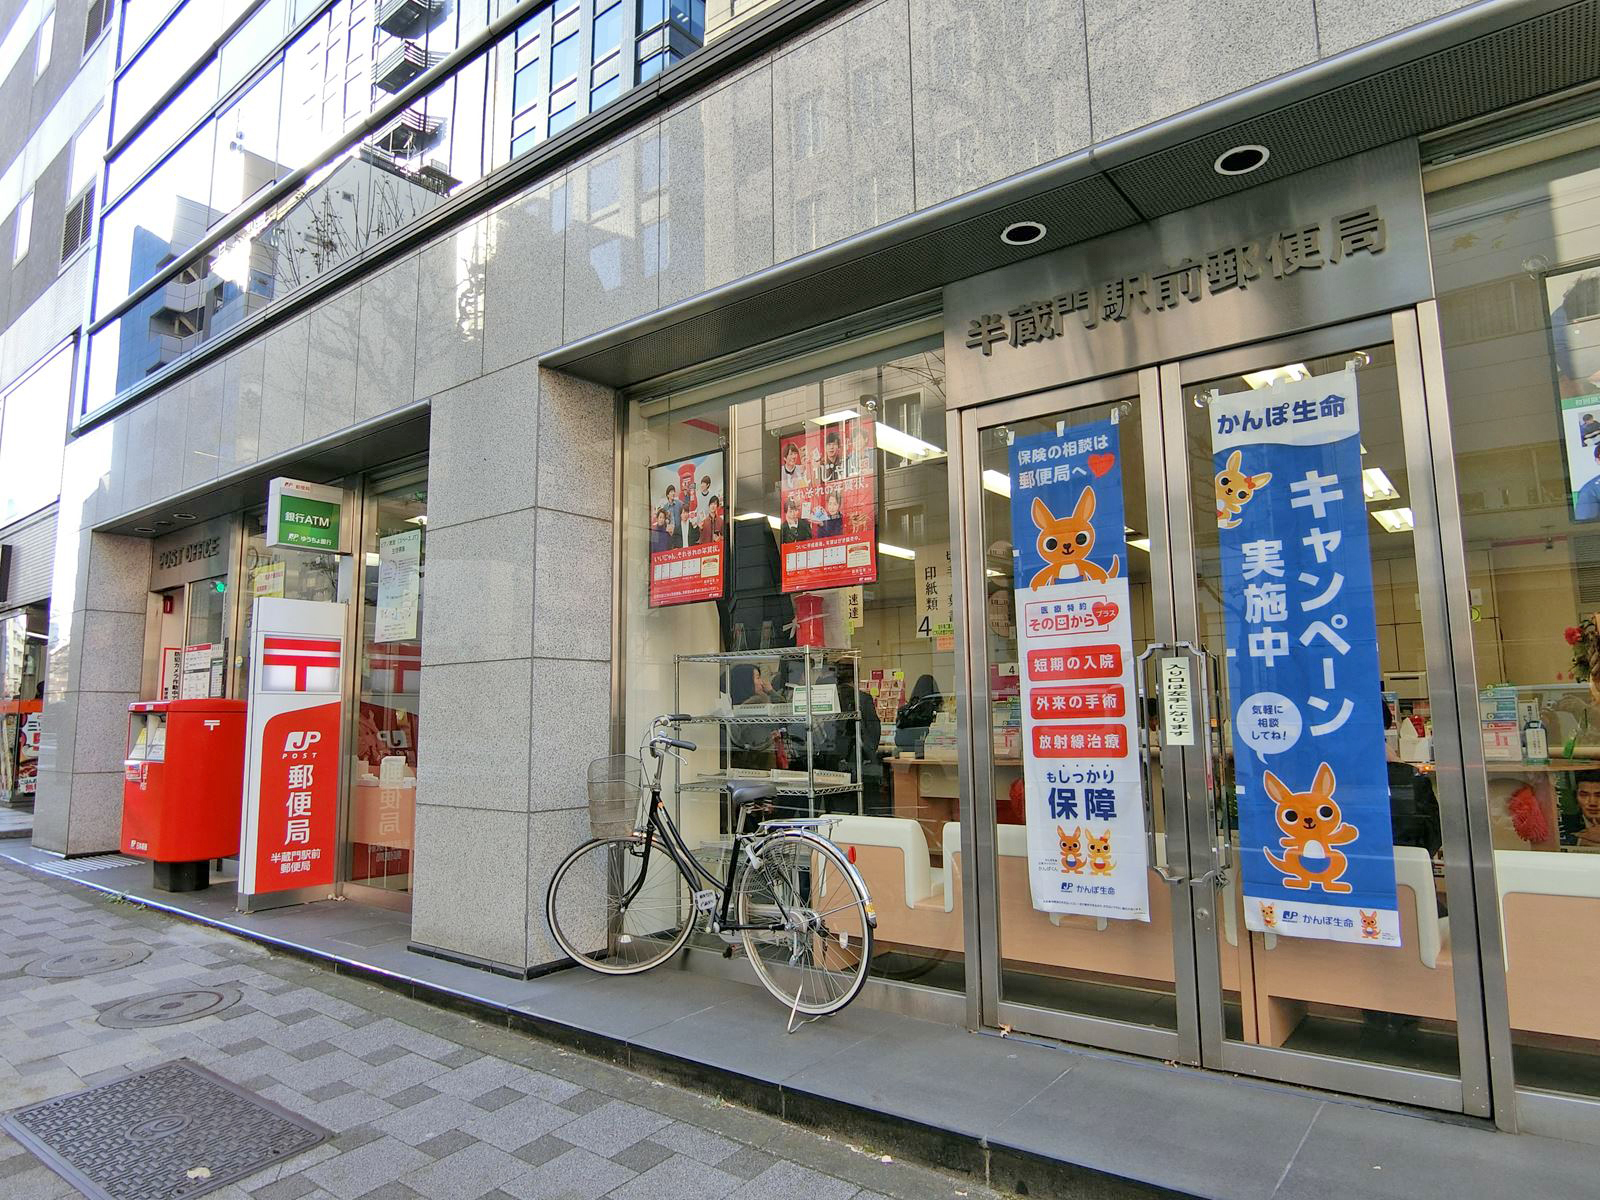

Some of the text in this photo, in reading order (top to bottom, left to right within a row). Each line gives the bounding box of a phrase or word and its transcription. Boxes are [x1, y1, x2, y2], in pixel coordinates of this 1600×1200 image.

[965, 204, 1388, 357] 半蔵門駅前郵便局
[1216, 394, 1347, 435] かんぽ生命
[1017, 434, 1109, 466] 保険の相談は
[1018, 464, 1088, 490] 郵便局へ
[284, 511, 330, 528] 銀行ATM
[924, 566, 939, 612] 印紙類
[848, 593, 859, 620] 速達
[1040, 602, 1087, 615] 医療特約
[1240, 538, 1290, 669] 実施中
[1290, 469, 1355, 738] キャンペーン
[1096, 608, 1116, 618] プラス
[918, 616, 932, 637] 4
[1008, 665, 1016, 675] 4
[1034, 654, 1115, 673] 短期の入院
[1036, 693, 1118, 711] 外来の手術
[1251, 704, 1284, 715] 気軽に
[1257, 718, 1280, 728] 相談
[283, 731, 321, 752] JP
[1039, 733, 1121, 750] 放射線治療
[281, 752, 318, 760] POST
[1046, 769, 1115, 785] もしっかり
[284, 764, 314, 846] 郵便局
[1047, 787, 1118, 821] 保障
[270, 848, 321, 864] 半蔵門駅前
[280, 860, 311, 874] 郵便局
[1076, 885, 1116, 896] かんぽ生命
[1282, 910, 1298, 920] JP
[1302, 914, 1354, 928] かんぽ生命
